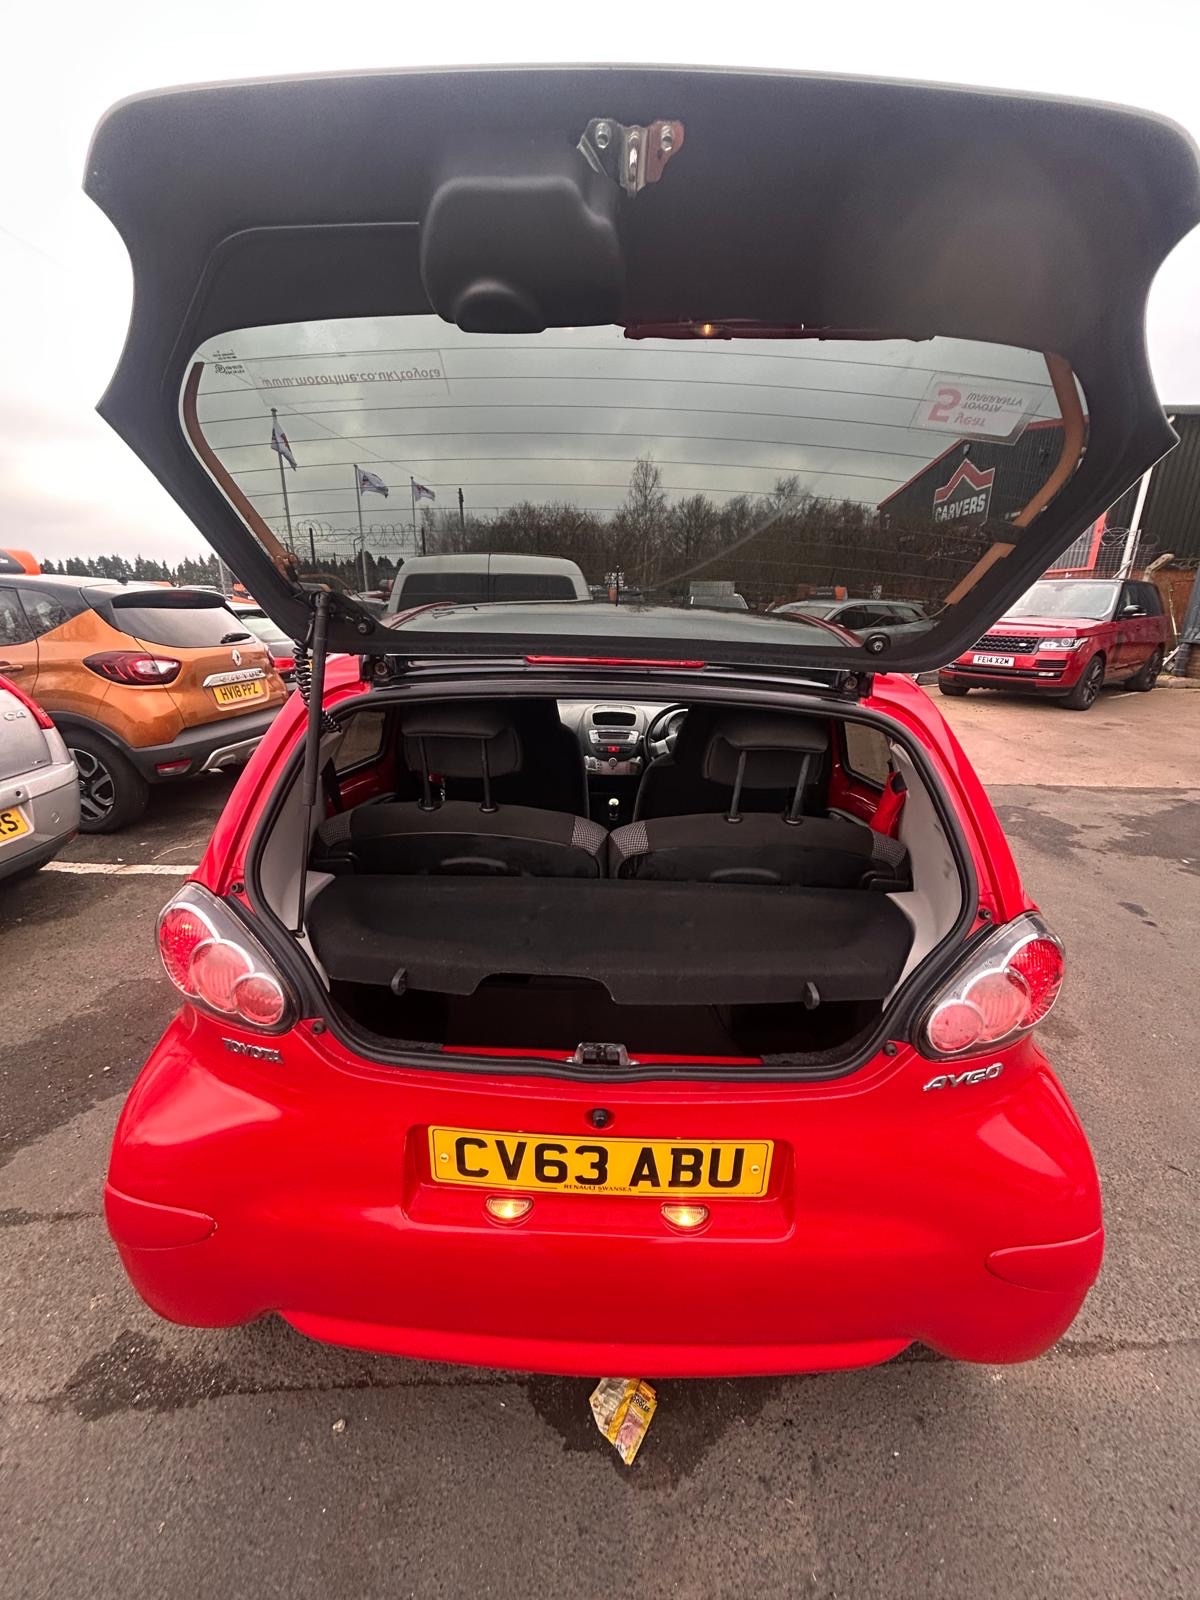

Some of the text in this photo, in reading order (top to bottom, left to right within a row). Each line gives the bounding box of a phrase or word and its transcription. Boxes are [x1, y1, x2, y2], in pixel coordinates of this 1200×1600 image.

[934, 493, 986, 523] CARVERS
[977, 656, 993, 664] FE14
[4, 710, 27, 721] C4
[221, 1036, 284, 1064] TOYOTA
[922, 1062, 1004, 1092] AYGO
[454, 1136, 745, 1188] CV63 ABU
